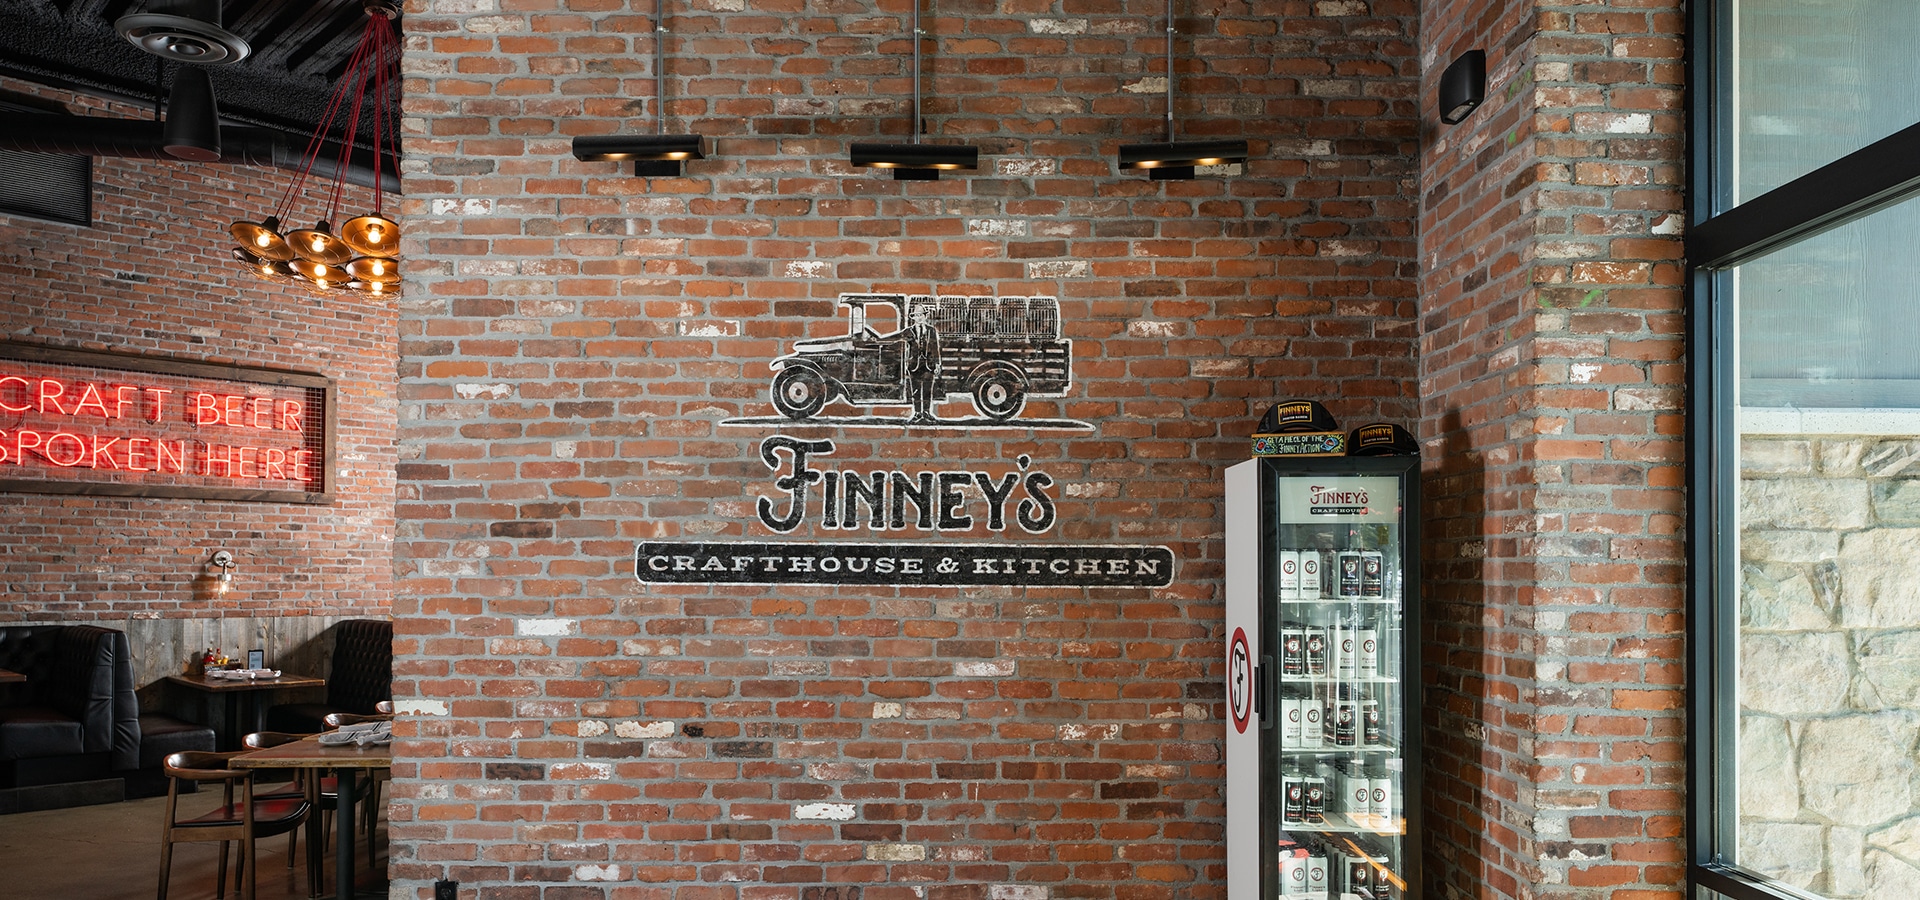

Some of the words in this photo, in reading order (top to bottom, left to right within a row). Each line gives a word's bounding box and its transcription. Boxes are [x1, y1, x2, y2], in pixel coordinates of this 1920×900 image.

[0, 376, 173, 423] CRAFT
[197, 393, 303, 432] BEER
[206, 443, 313, 481] HERE
[757, 435, 1057, 534] FINNEY'S
[648, 555, 924, 575] CRAFTHOUSE
[936, 557, 960, 574] &
[972, 558, 1162, 575] KITCHEN
